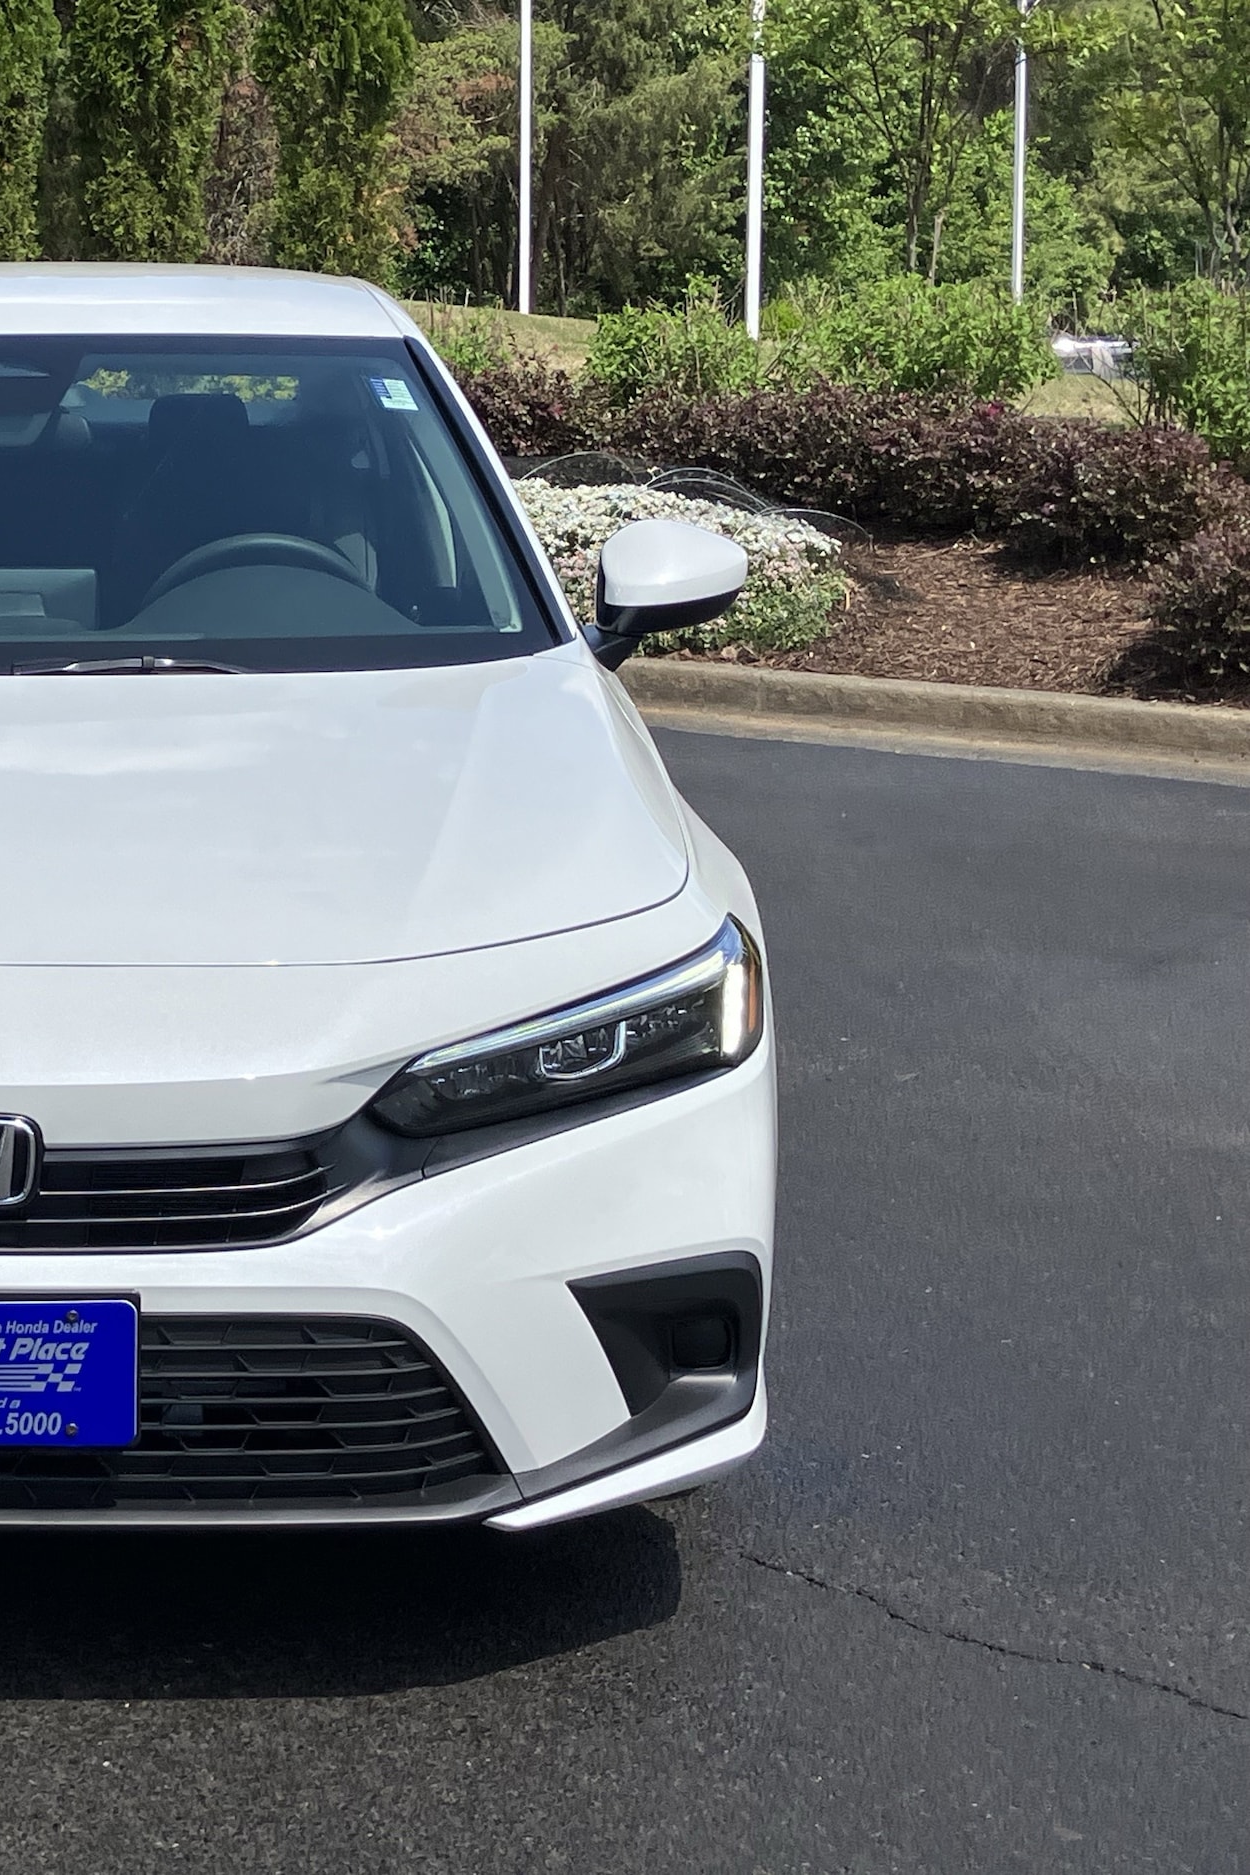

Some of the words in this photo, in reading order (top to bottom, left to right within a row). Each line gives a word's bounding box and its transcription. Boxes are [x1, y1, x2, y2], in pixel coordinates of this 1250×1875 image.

[5, 1320, 49, 1334] Honda
[53, 1320, 98, 1334] Dealer
[9, 1337, 90, 1360] Place
